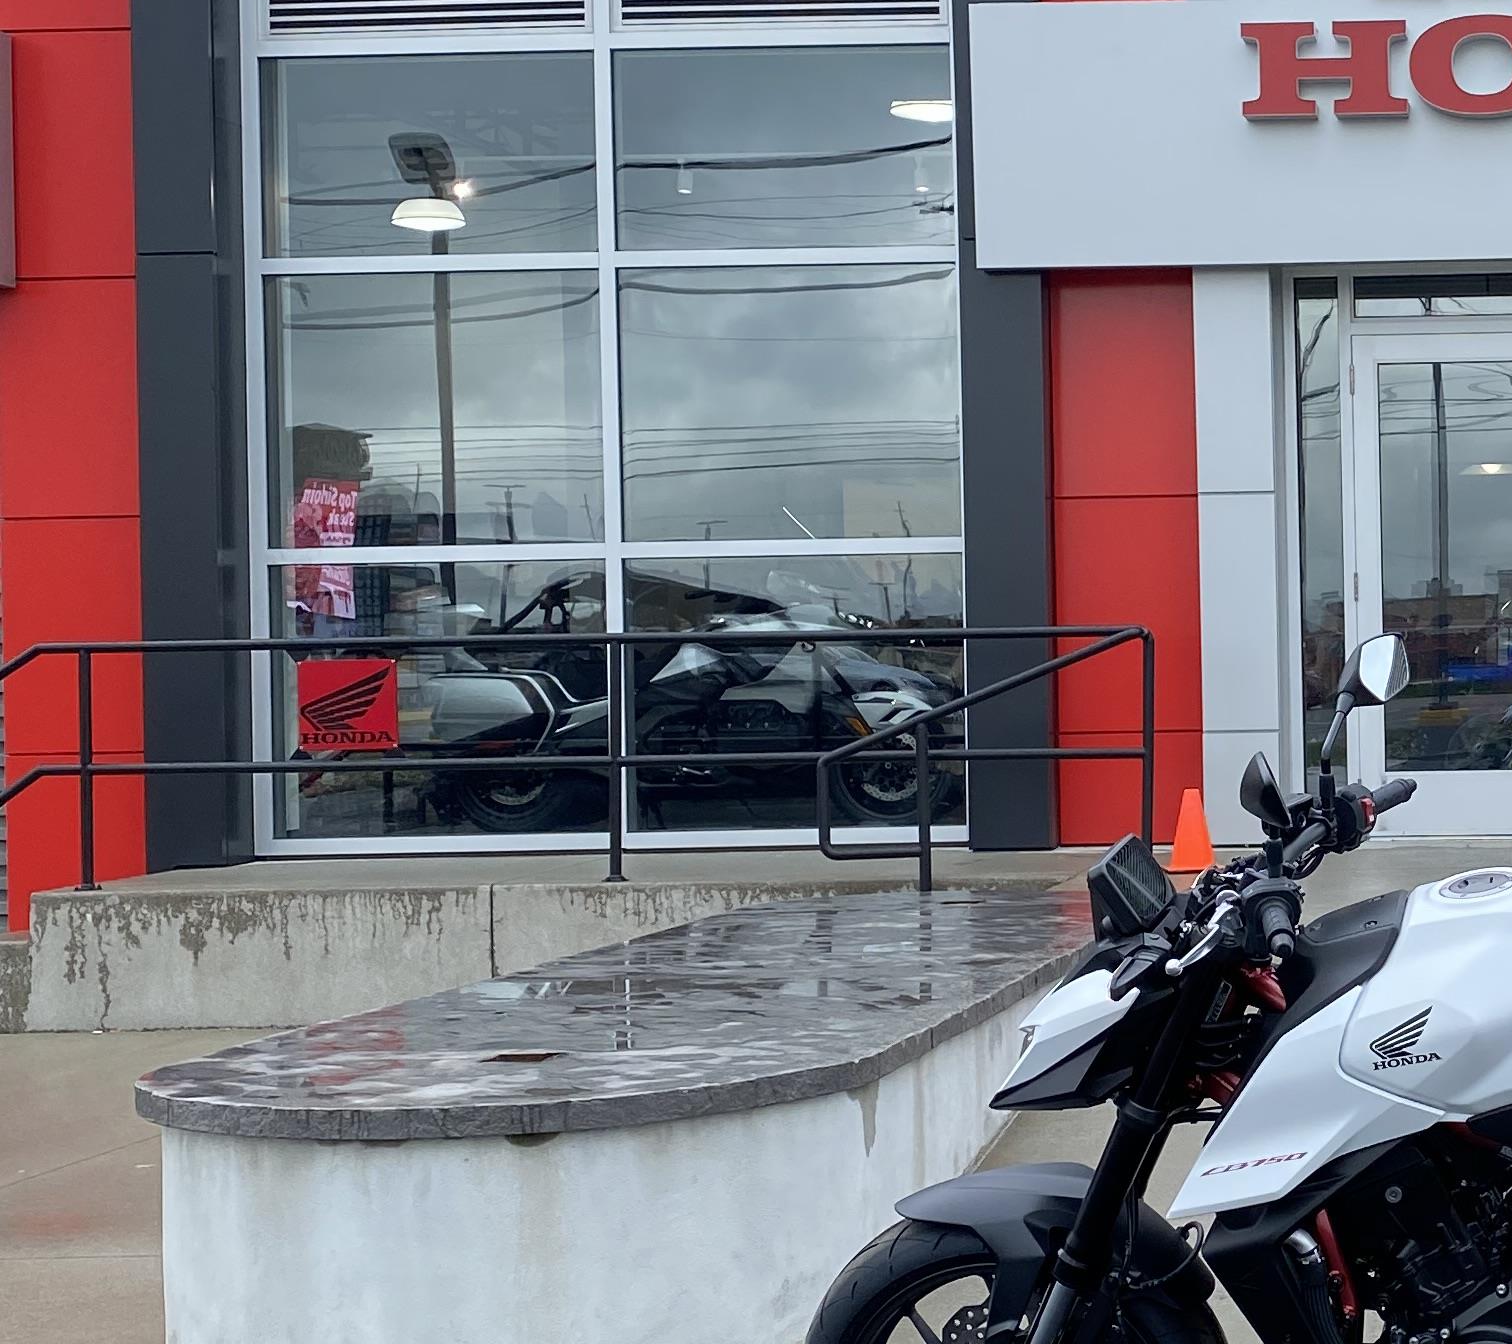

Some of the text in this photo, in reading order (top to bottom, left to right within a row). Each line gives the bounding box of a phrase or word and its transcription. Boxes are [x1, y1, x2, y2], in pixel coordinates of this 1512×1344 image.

[301, 731, 397, 744] HONDA
[1372, 1052, 1442, 1071] HONDA
[1200, 1152, 1308, 1177] CB750
